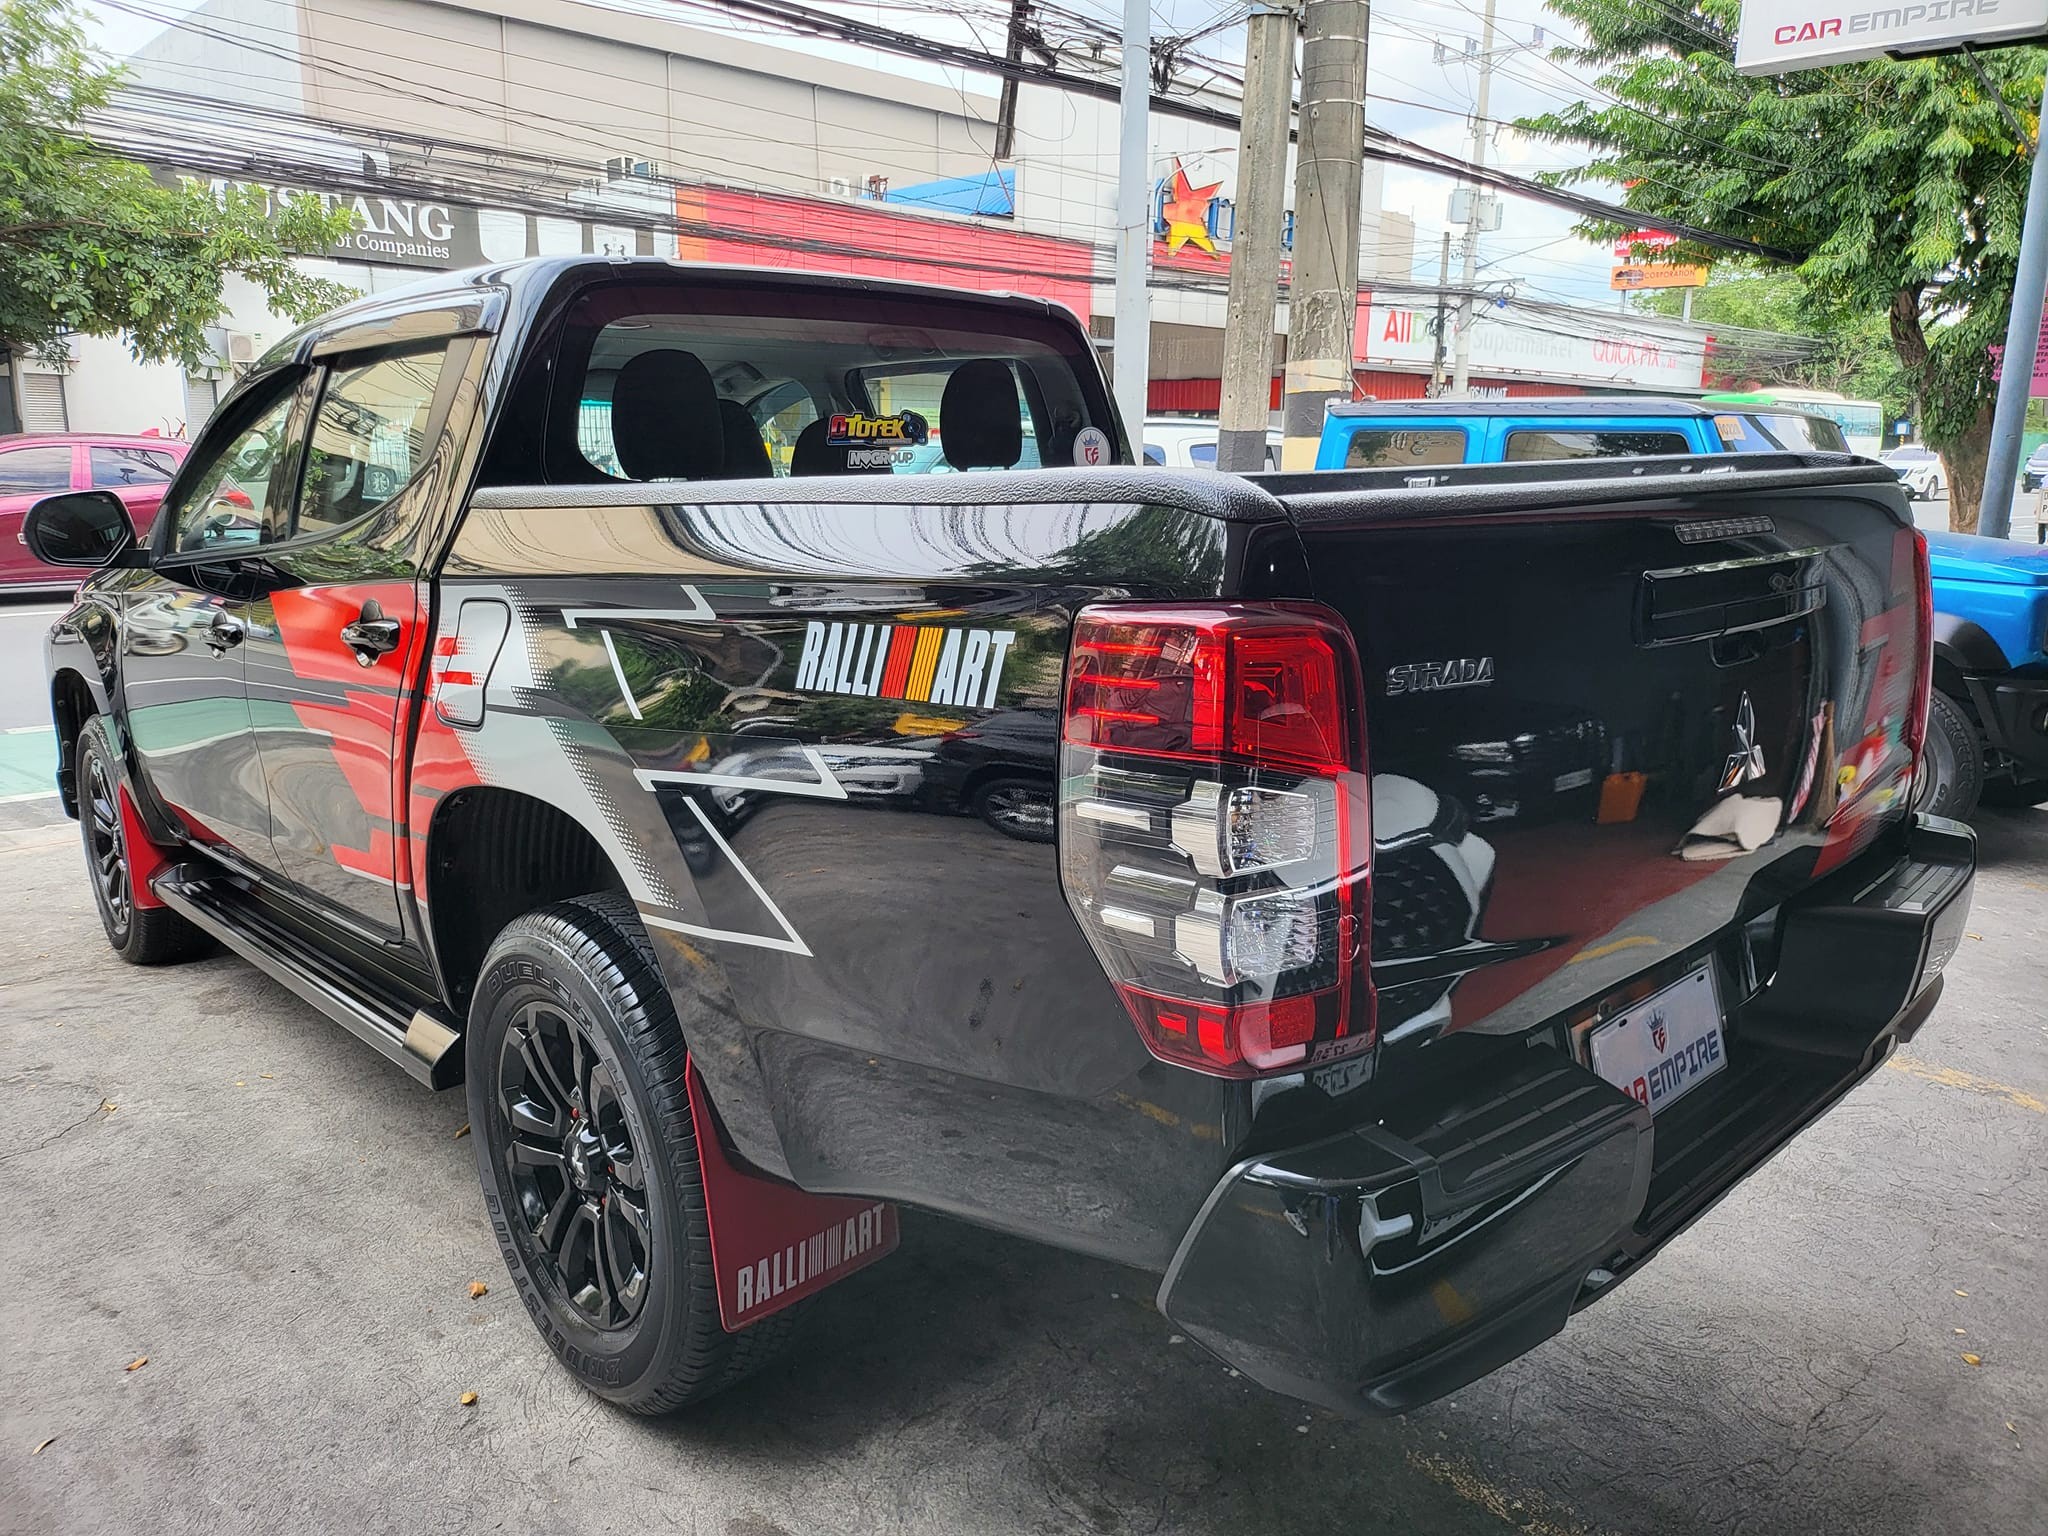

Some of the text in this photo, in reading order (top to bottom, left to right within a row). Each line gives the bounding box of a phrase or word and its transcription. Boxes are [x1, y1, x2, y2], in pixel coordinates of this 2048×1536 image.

[1774, 0, 1999, 45] CAR EMPIRE
[356, 234, 450, 259] Companies
[1472, 325, 1574, 359] Supermarket
[1386, 657, 1495, 697] STRADA
[1648, 1029, 1720, 1102] EMPIRE
